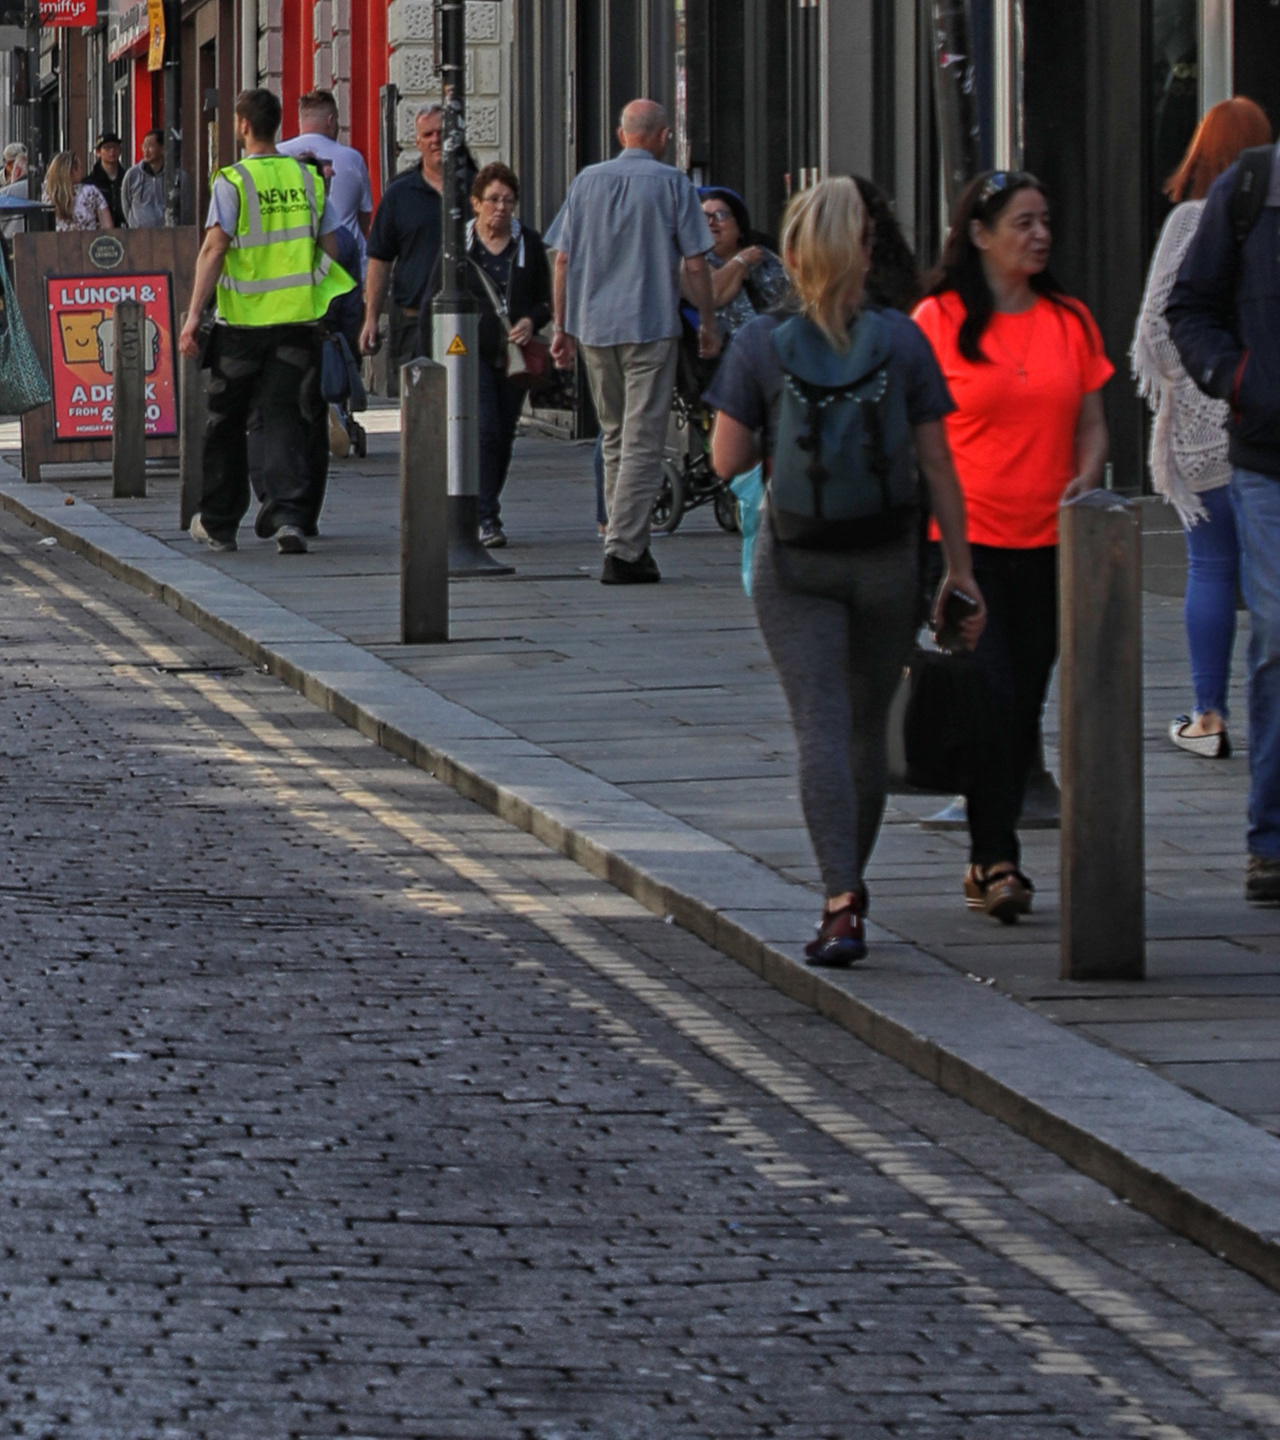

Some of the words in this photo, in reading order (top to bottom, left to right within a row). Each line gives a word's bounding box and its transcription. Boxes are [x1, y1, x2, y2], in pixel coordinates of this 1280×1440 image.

[258, 188, 307, 205] NEWRY
[61, 286, 135, 305] LUNCH
[140, 285, 156, 302] &
[71, 385, 87, 403] A
[69, 407, 98, 417] FROM
